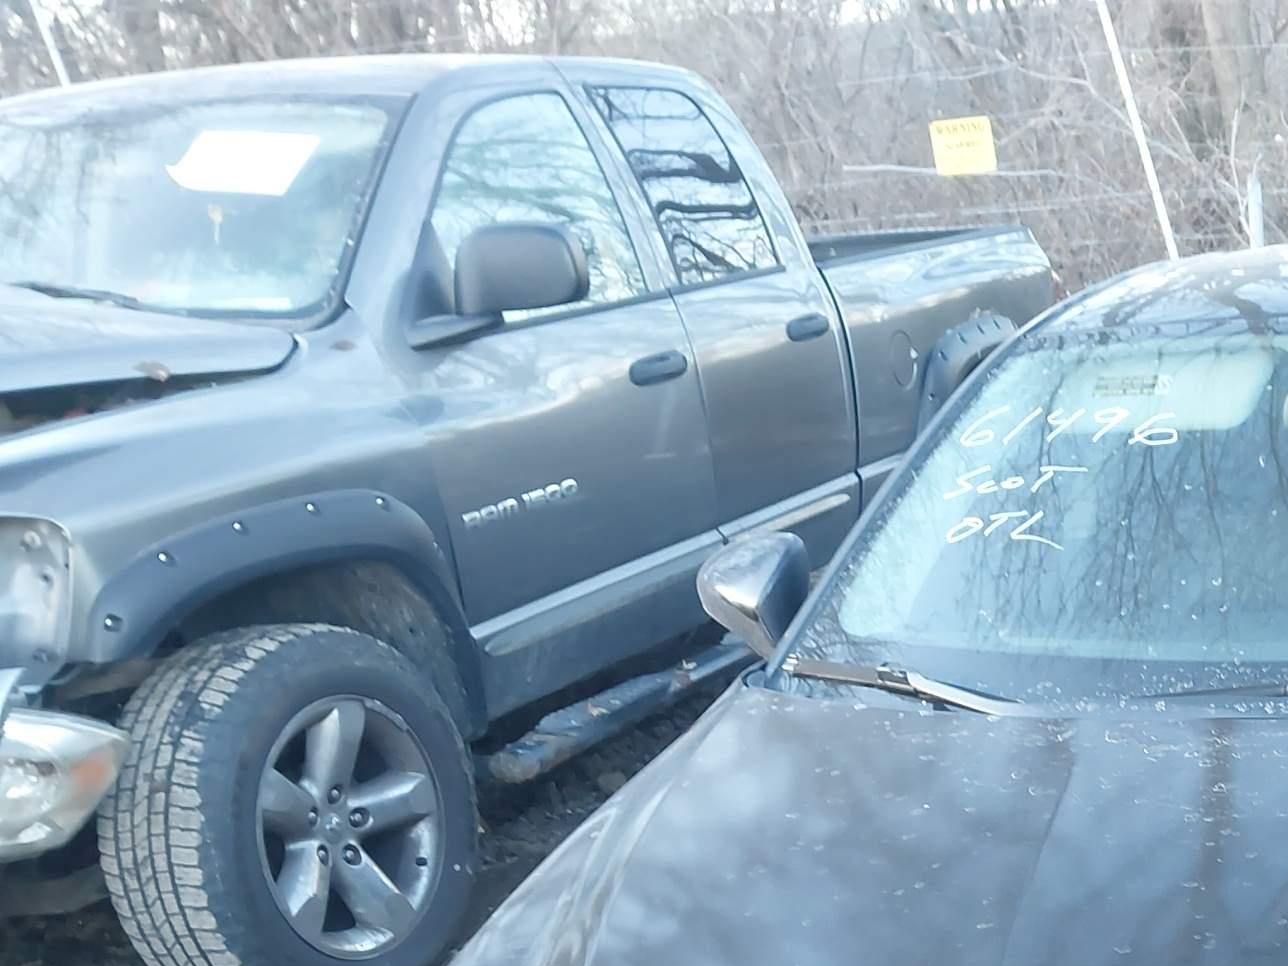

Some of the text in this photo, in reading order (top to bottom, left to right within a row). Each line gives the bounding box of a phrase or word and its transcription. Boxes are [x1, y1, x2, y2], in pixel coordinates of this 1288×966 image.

[959, 404, 1178, 447] 61496
[461, 478, 578, 526] RAM 1500
